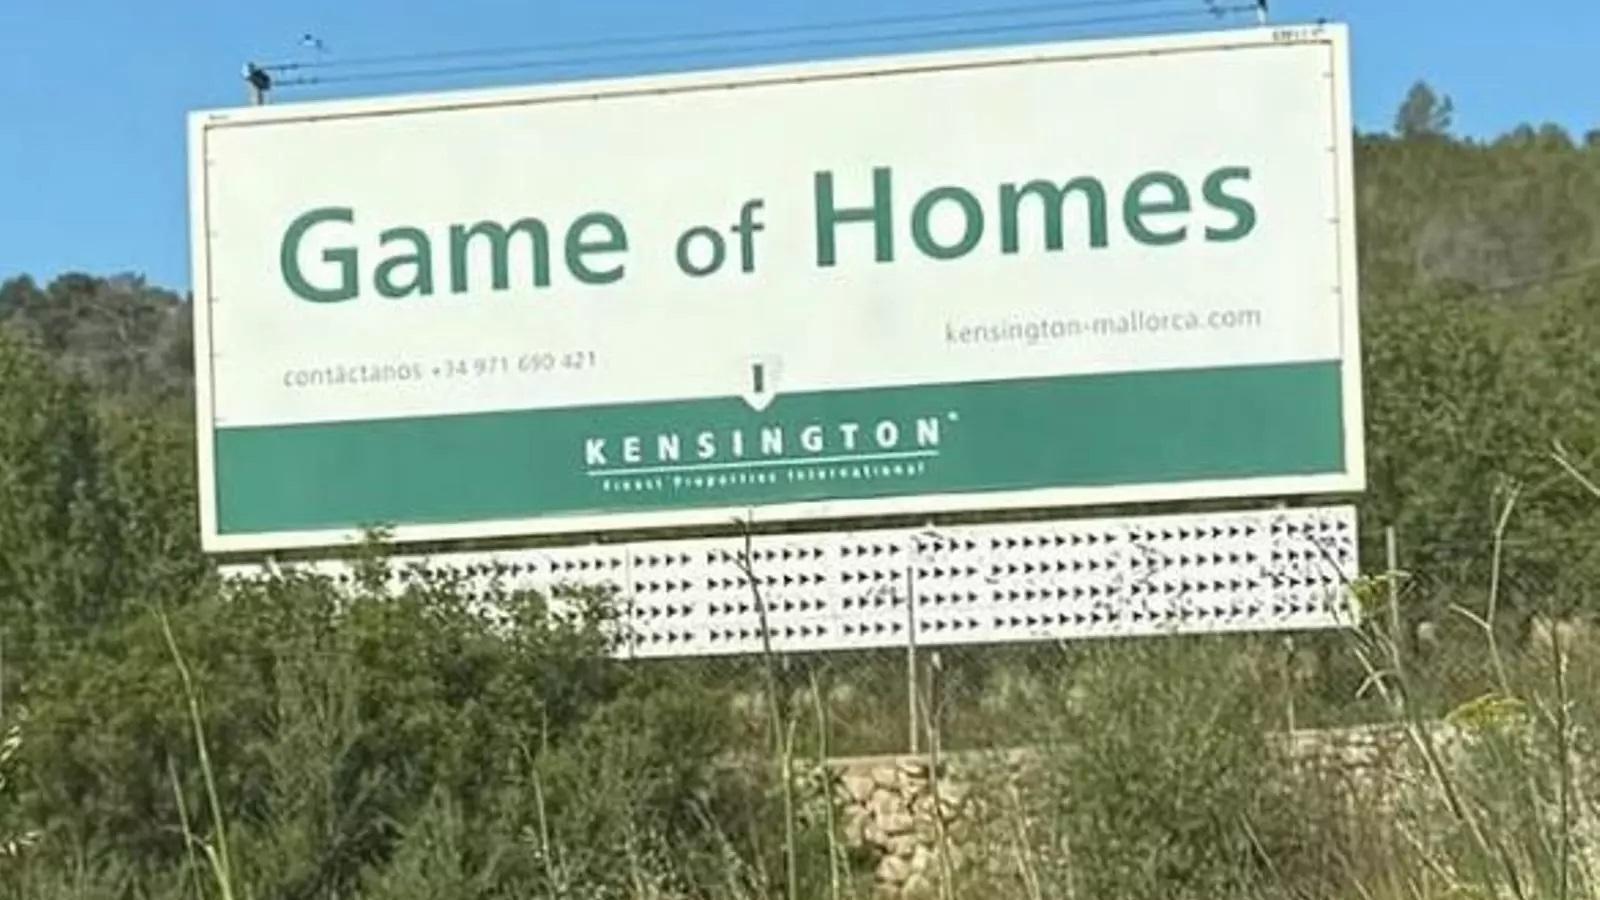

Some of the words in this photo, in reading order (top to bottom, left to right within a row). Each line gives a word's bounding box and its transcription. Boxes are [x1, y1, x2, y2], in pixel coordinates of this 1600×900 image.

[280, 206, 629, 304] Game
[675, 198, 765, 278] of
[813, 166, 1258, 268] Homes
[944, 308, 1262, 346] kensington-mallorca.com
[474, 356, 509, 376] 971
[585, 417, 941, 466] KENSINGTON
